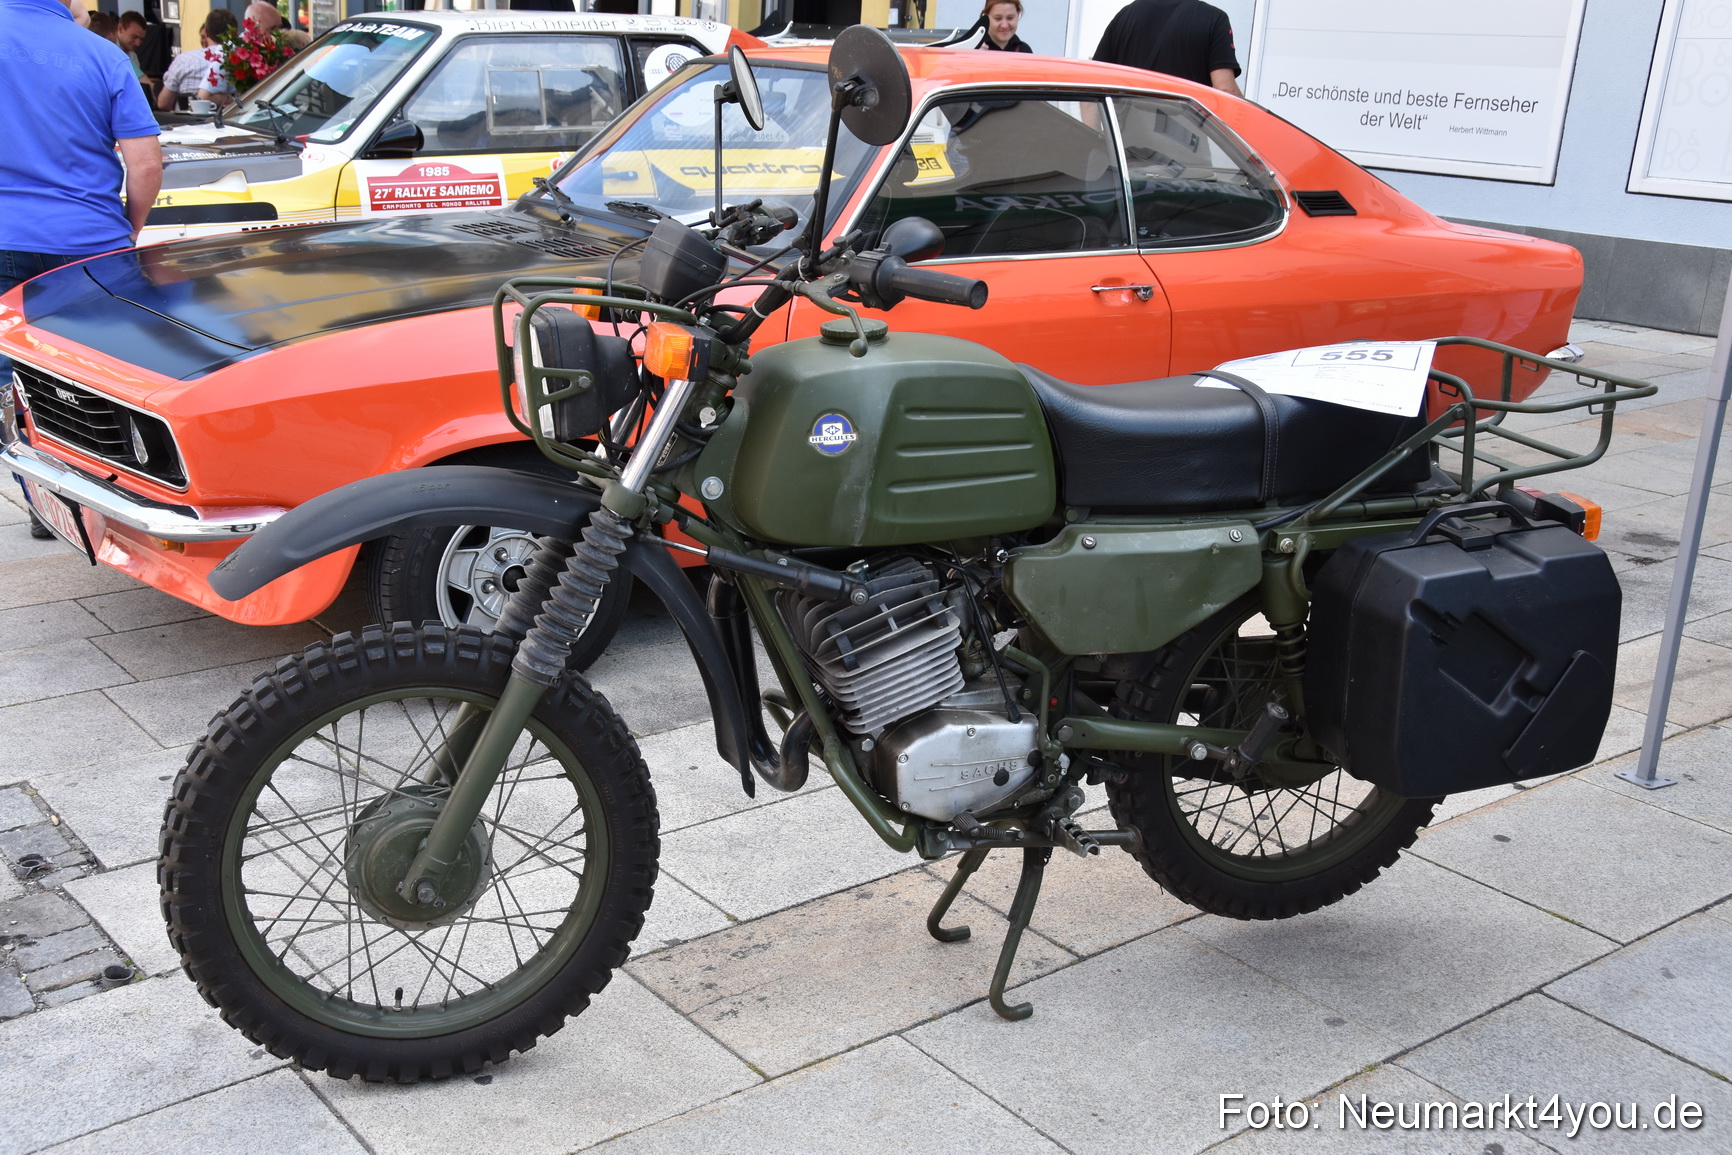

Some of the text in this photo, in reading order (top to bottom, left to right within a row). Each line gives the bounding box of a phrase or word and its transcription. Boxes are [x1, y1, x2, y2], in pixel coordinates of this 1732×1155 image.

[474, 17, 619, 31] Bierschneider
[374, 23, 426, 41] TEAM
[1306, 85, 1370, 103] schönste
[1374, 89, 1402, 106] und
[1406, 90, 1449, 108] beste
[1453, 92, 1539, 114] Fernseher
[1360, 110, 1384, 127] der
[1449, 125, 1508, 137] Herbert Wittmann
[419, 166, 450, 177] 1985
[680, 163, 823, 178] quattro
[394, 186, 437, 198] RALLYE
[440, 184, 495, 196] SANREMO
[1319, 349, 1394, 362] 555
[56, 388, 79, 405] OPEL
[811, 434, 855, 442] HERCULES
